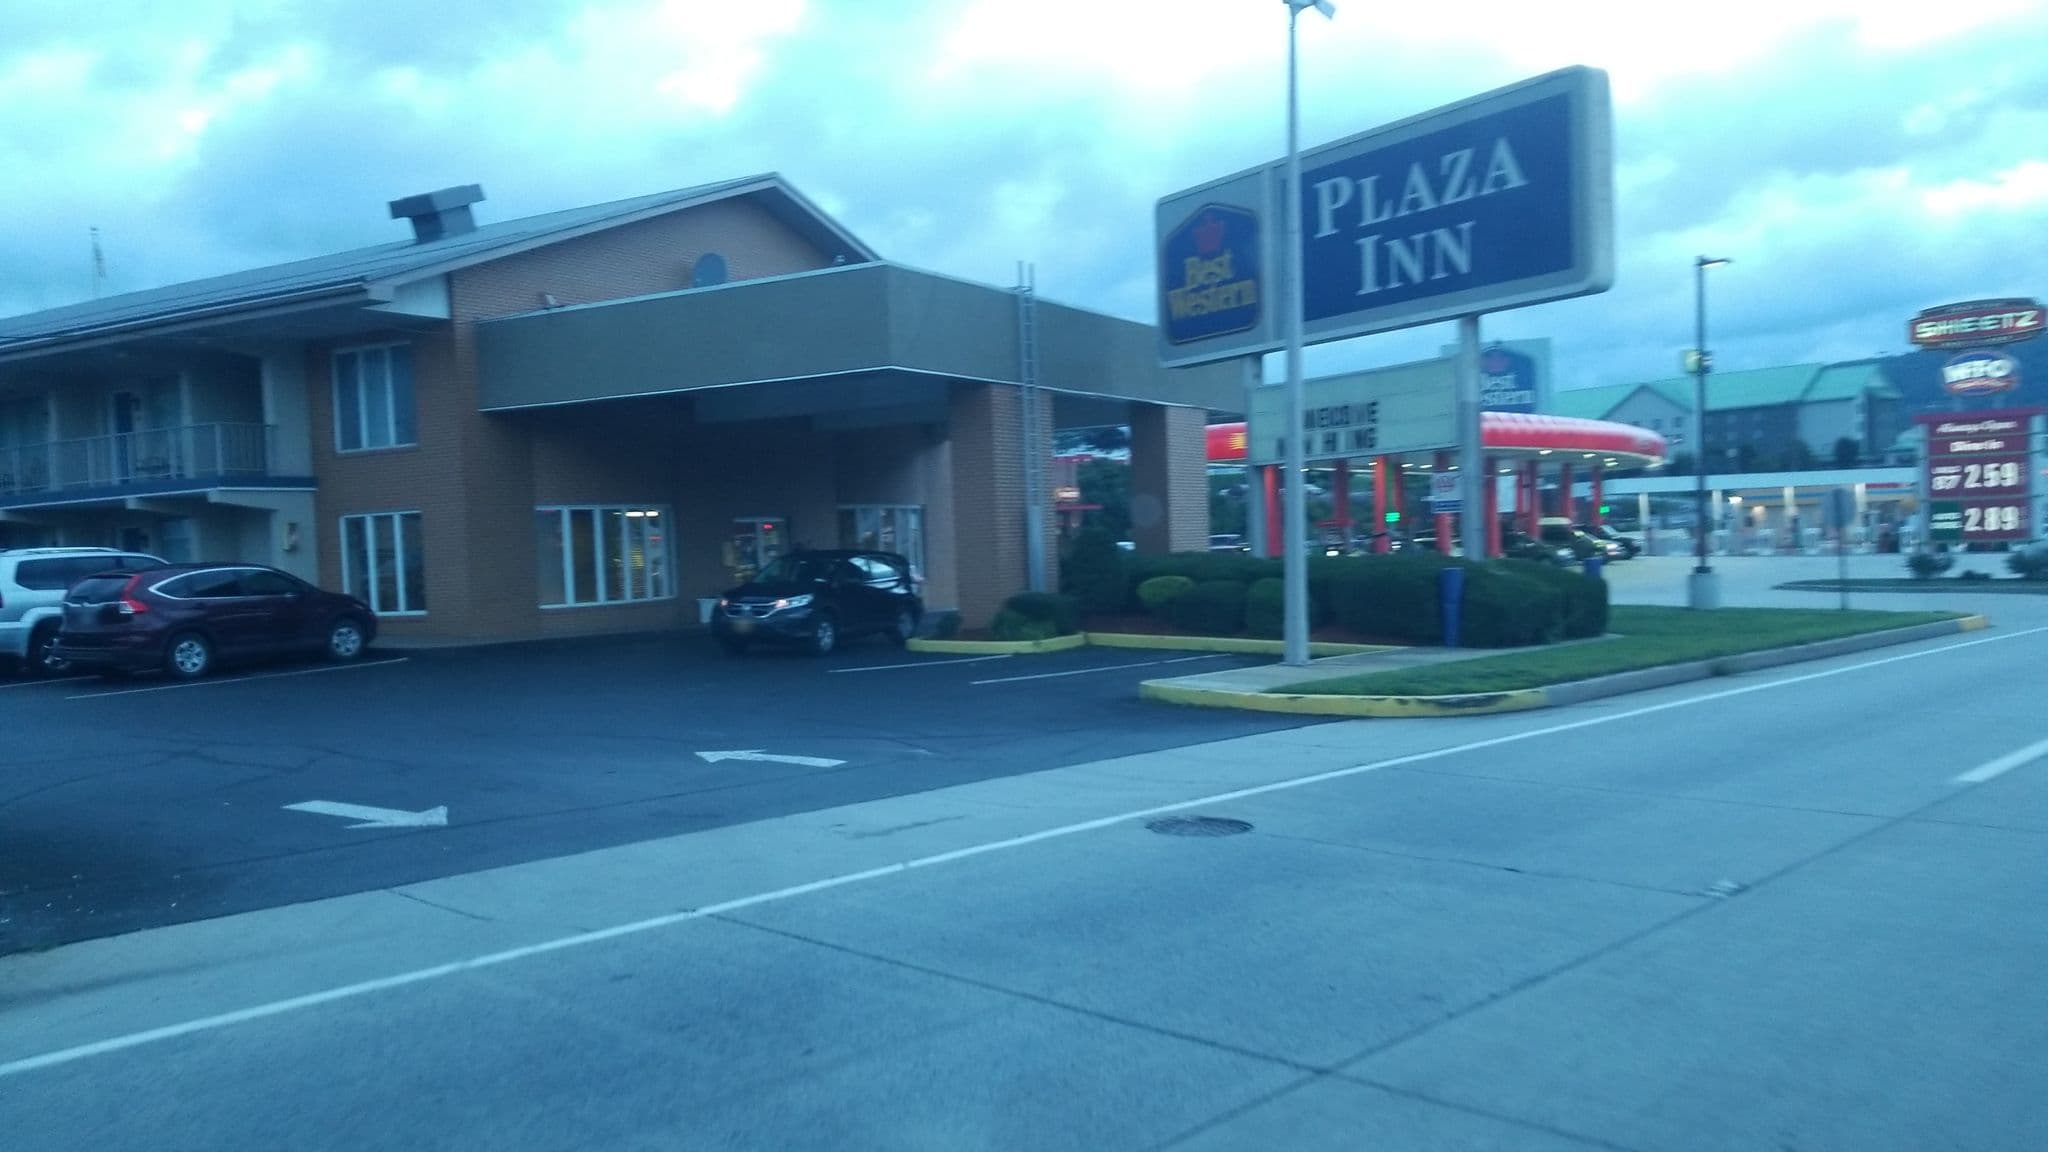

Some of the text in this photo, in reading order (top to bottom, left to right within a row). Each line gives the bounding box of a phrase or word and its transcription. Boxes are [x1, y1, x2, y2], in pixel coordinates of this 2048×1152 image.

[1313, 136, 1529, 239] PLAZA
[1183, 247, 1234, 290] Best
[1356, 220, 1476, 296] INN
[1167, 279, 1257, 320] Western
[1914, 309, 2040, 339] SHEETZ
[1304, 400, 1379, 430] WELCOME
[1963, 462, 2019, 489] 259
[1963, 505, 2020, 532] 289
